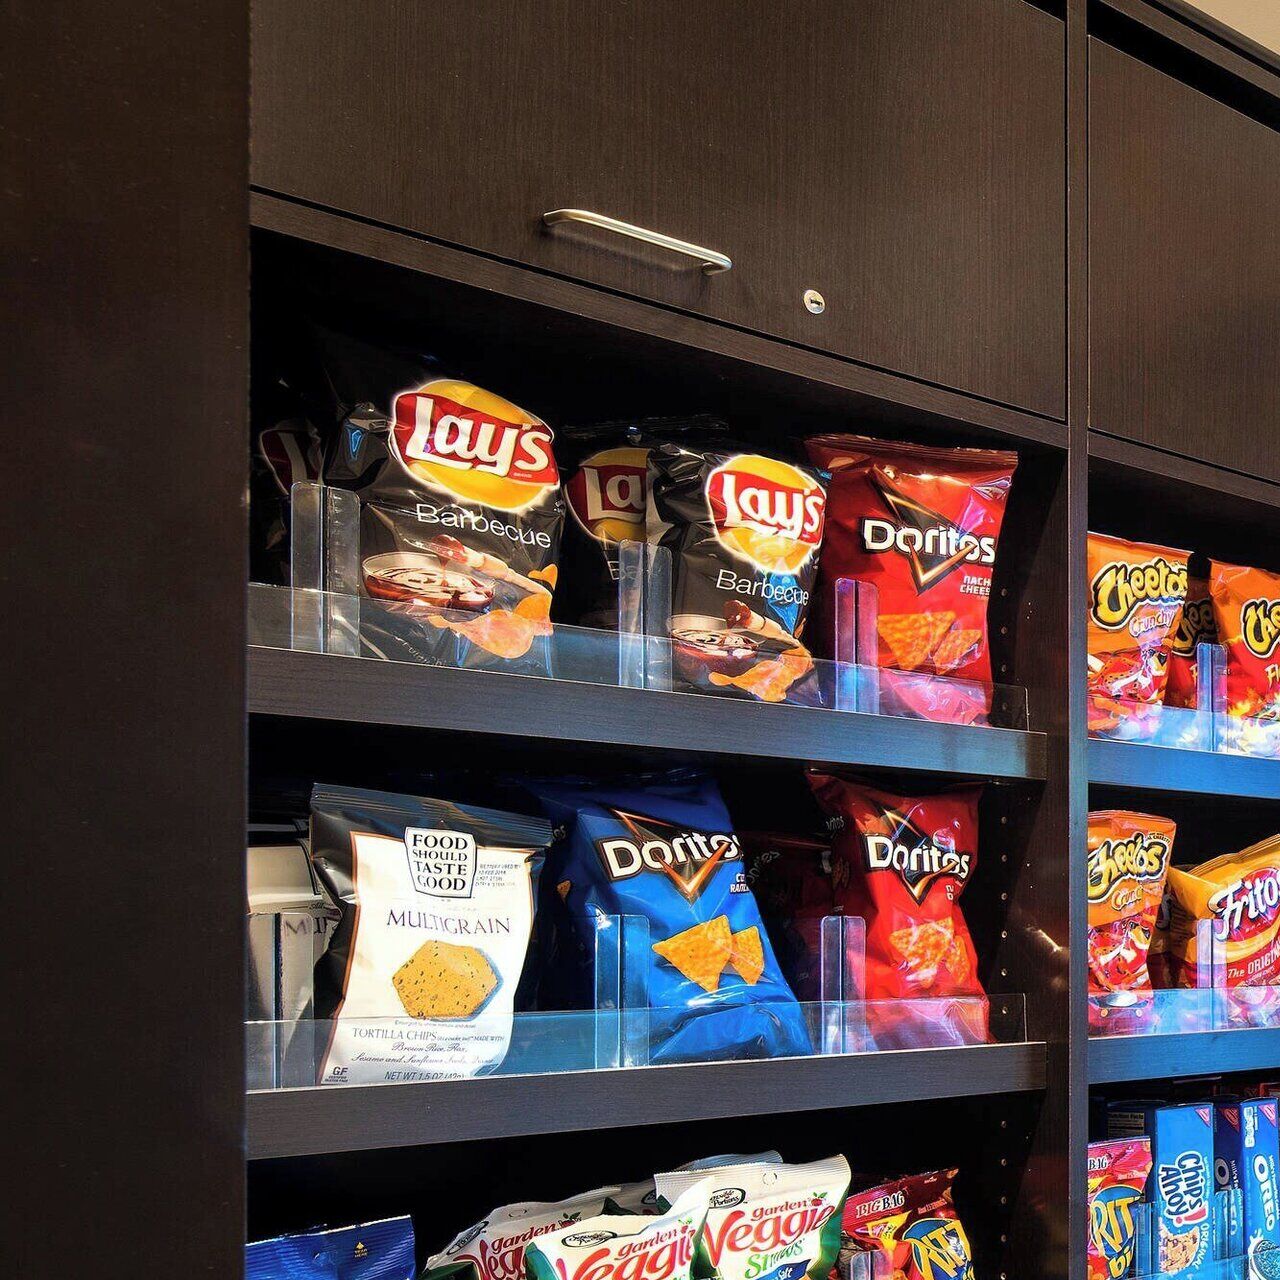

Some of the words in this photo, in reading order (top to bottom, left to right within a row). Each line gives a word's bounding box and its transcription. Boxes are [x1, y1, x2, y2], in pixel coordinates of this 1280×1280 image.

[405, 394, 553, 477] Lay's
[416, 503, 552, 550] Barbecue
[723, 473, 824, 541] Lay's
[863, 519, 997, 563] Doritos
[716, 569, 809, 606] Barbecue
[1092, 557, 1188, 628] Cheeto
[412, 834, 468, 850] FOOD
[412, 850, 468, 862] SHOULD
[865, 835, 971, 879] Doritos
[413, 861, 467, 876] TASTE
[417, 875, 466, 891] GOOD
[387, 908, 511, 935] MULTIGRAIN
[1228, 967, 1245, 979] The
[352, 1028, 404, 1040] TORTILLA
[406, 1030, 438, 1041] CHIPS
[856, 1201, 881, 1218] BIG
[882, 1191, 906, 1209] BAG
[1159, 1165, 1208, 1226] Ahoy!
[1176, 1152, 1207, 1217] Chips
[1252, 1154, 1276, 1232] OREO
[752, 1198, 809, 1222] garden
[1089, 1196, 1139, 1252] RIT
[492, 1222, 556, 1252] garden
[618, 1229, 678, 1260] garden
[704, 1204, 837, 1269] Veggie
[1194, 1222, 1211, 1271] ORIGINAL
